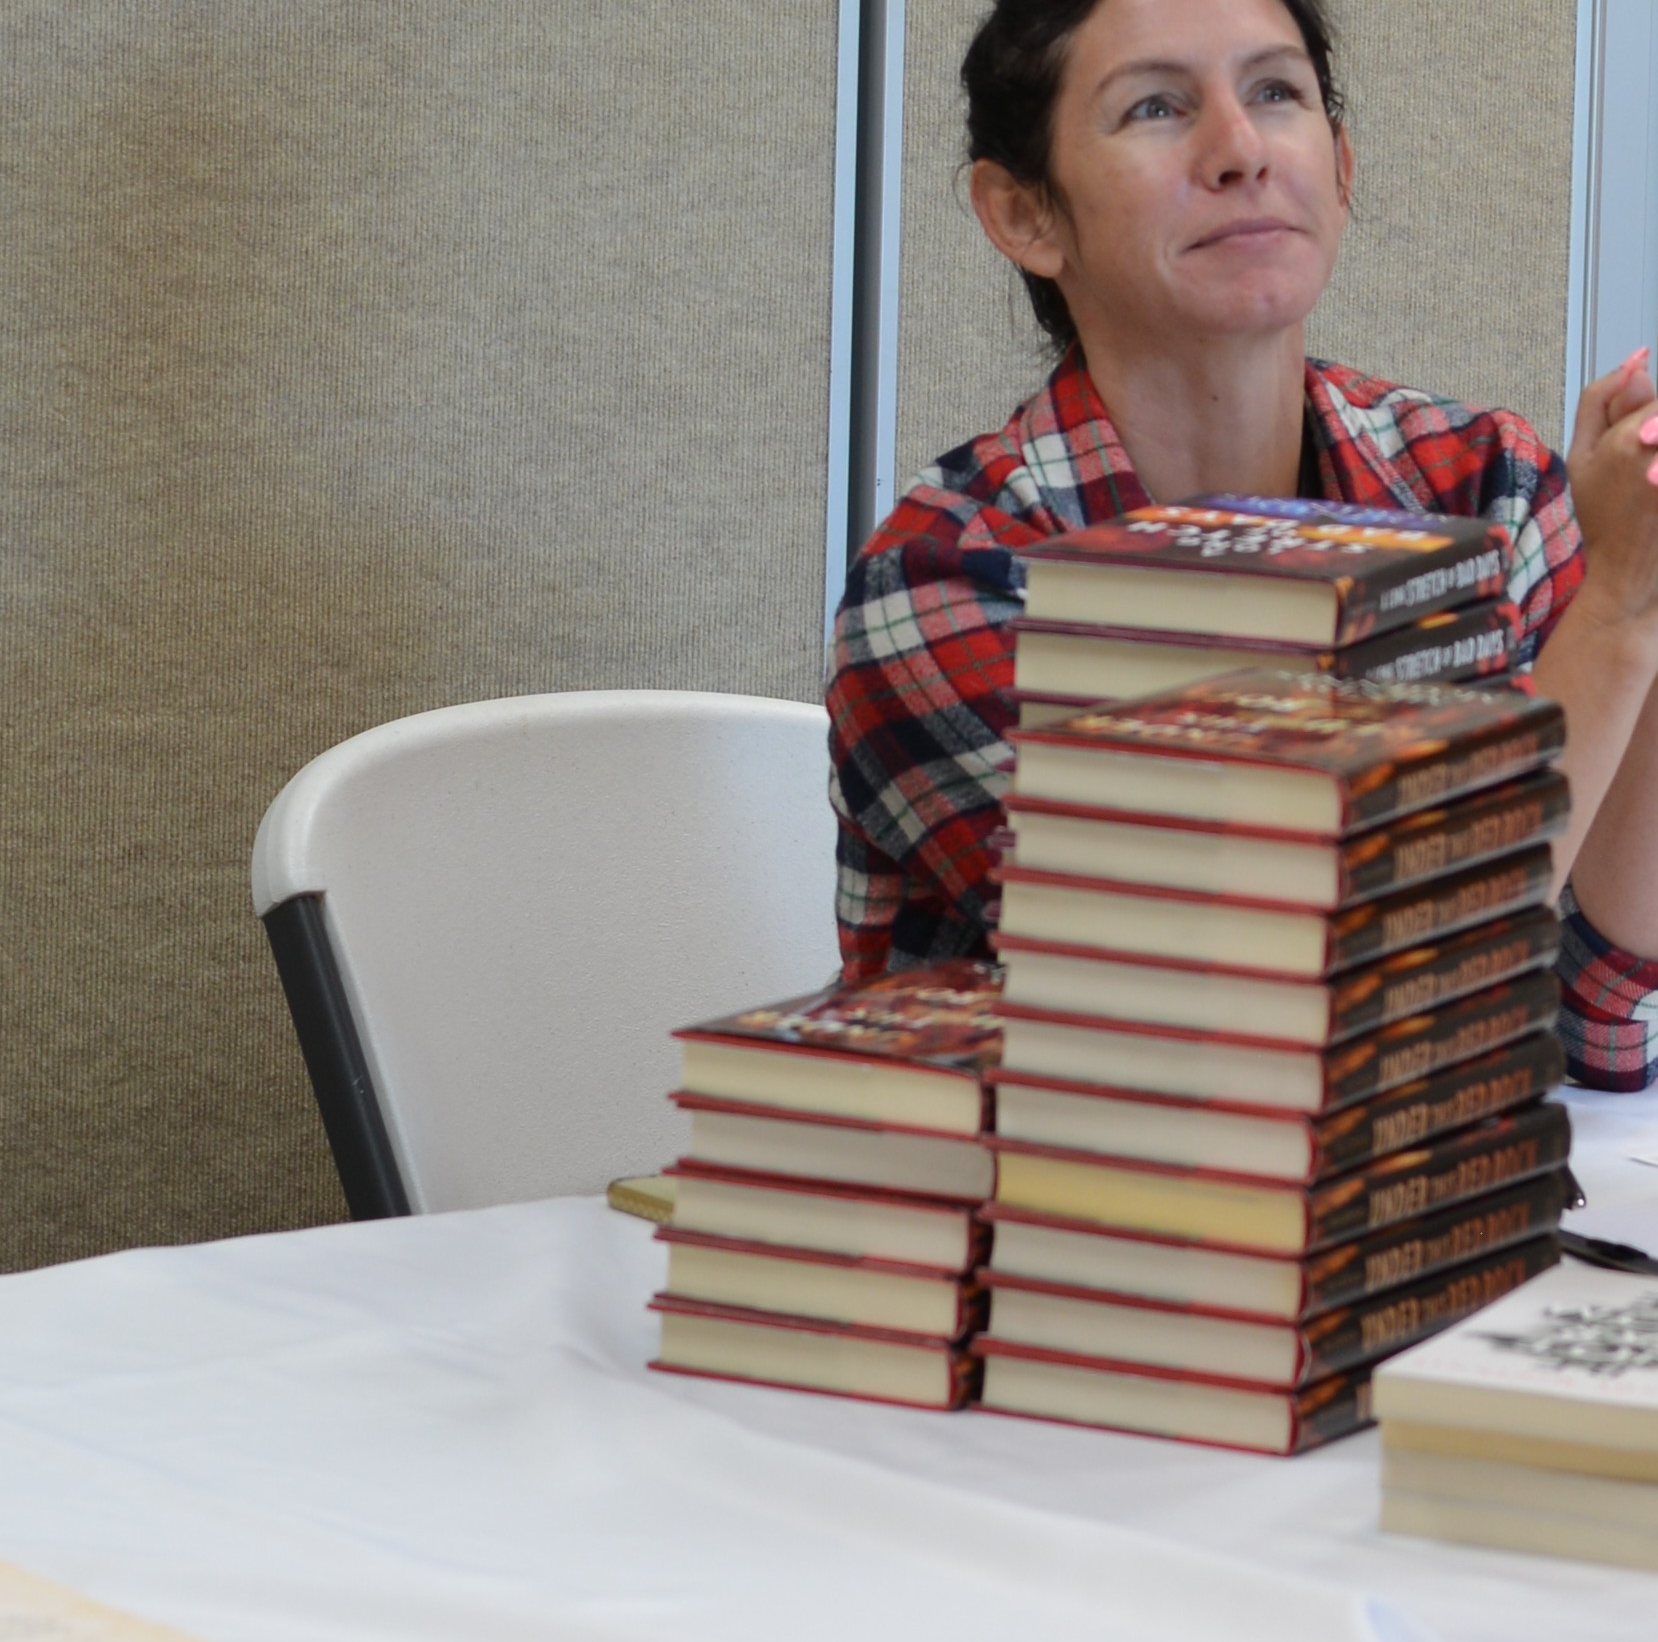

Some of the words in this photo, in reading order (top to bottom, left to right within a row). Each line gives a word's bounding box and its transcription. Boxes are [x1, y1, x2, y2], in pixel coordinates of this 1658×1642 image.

[1406, 566, 1446, 607] STRETCH
[1456, 556, 1474, 589] BAD
[1476, 548, 1499, 581] DAYS
[1395, 643, 1441, 686] STRETCH
[1453, 635, 1474, 668] BAD
[1477, 626, 1503, 660] DAYS
[1375, 1103, 1428, 1155] UNDER
[1371, 1176, 1427, 1227] UNDER
[1367, 1239, 1421, 1291] UNDER
[1362, 1298, 1419, 1353] UNDER
